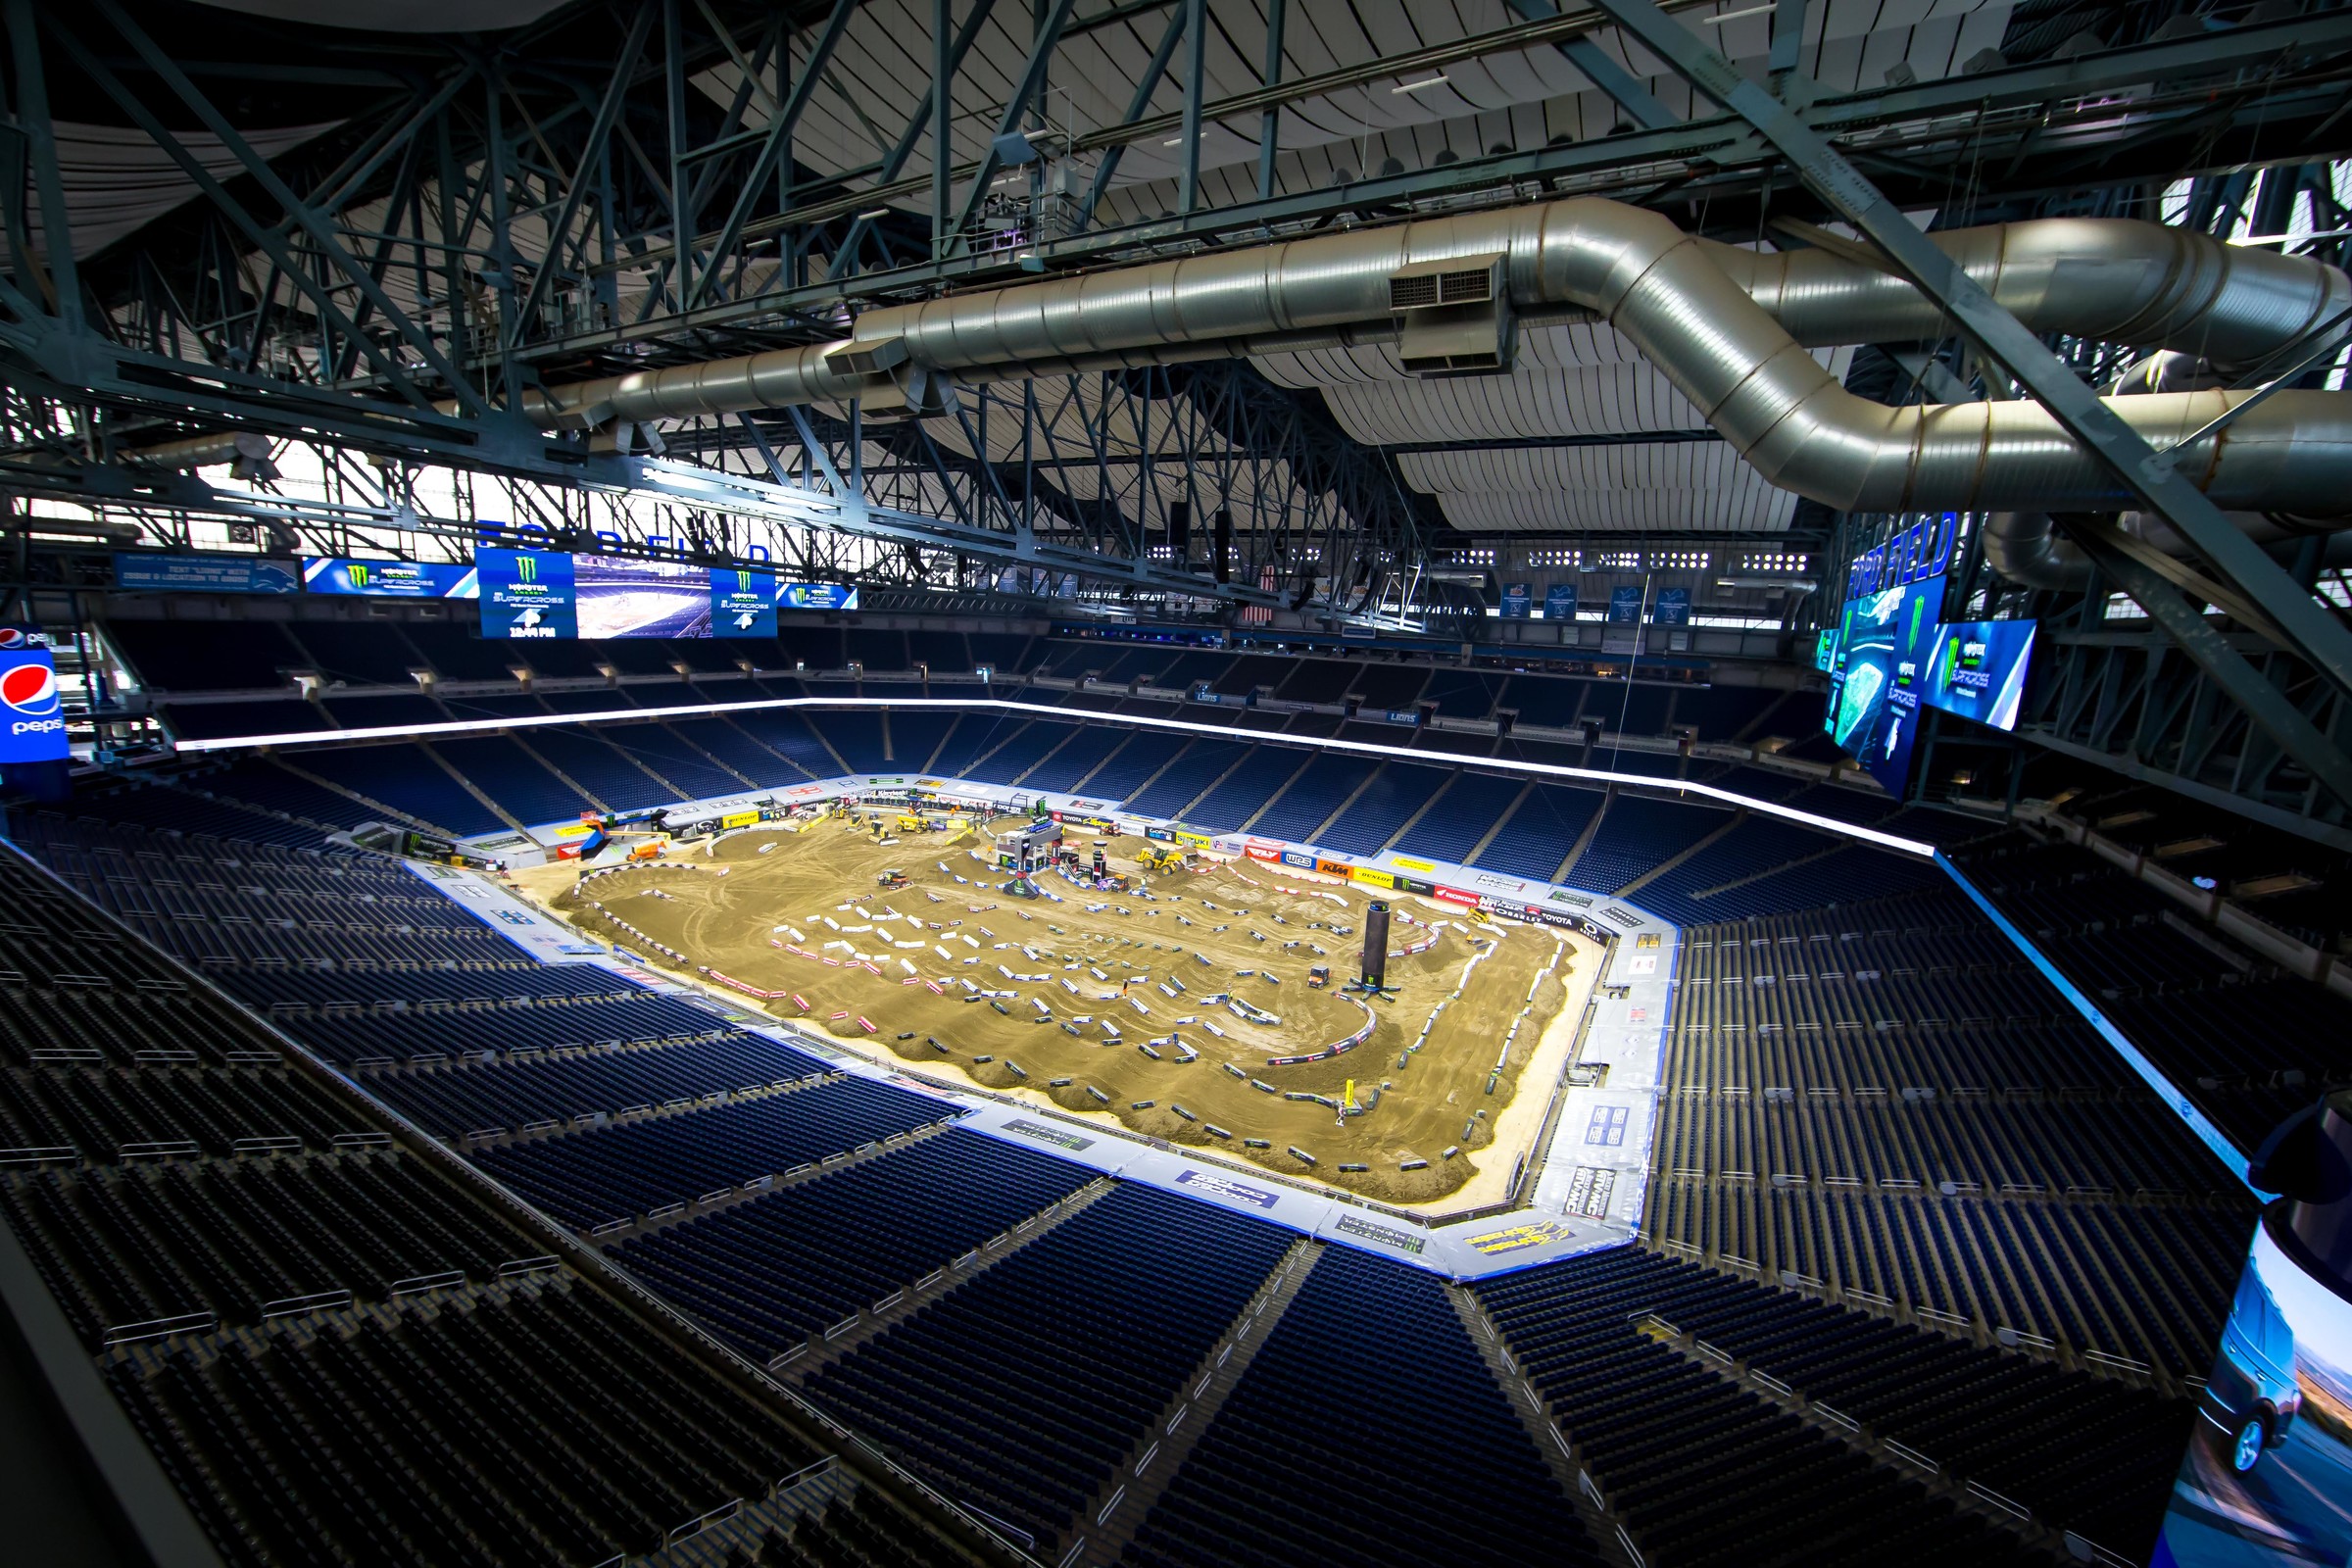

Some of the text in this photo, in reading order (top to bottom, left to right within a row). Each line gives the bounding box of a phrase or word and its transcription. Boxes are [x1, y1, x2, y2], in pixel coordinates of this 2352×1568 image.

[1883, 512, 1956, 590] FIELD
[380, 567, 418, 576] MONSTER
[509, 583, 548, 592] MONSTER
[493, 595, 564, 604] SUPERCROSS
[538, 627, 557, 637] PM
[1963, 641, 1985, 657] MONSTER
[1062, 814, 1082, 823] TOYOTA
[1149, 828, 1172, 837] GoPro
[1287, 855, 1311, 866] WPS
[1322, 863, 1348, 875] KTM
[1361, 872, 1393, 882] DUNLOP
[1446, 892, 1478, 905] HONDA
[1507, 911, 1542, 923] OAKLEY
[1542, 912, 1572, 926] TOYOTA
[1579, 927, 1600, 942] OAKLEY
[1345, 1217, 1405, 1240] MONSTER
[1340, 1224, 1403, 1248] MONSTER
